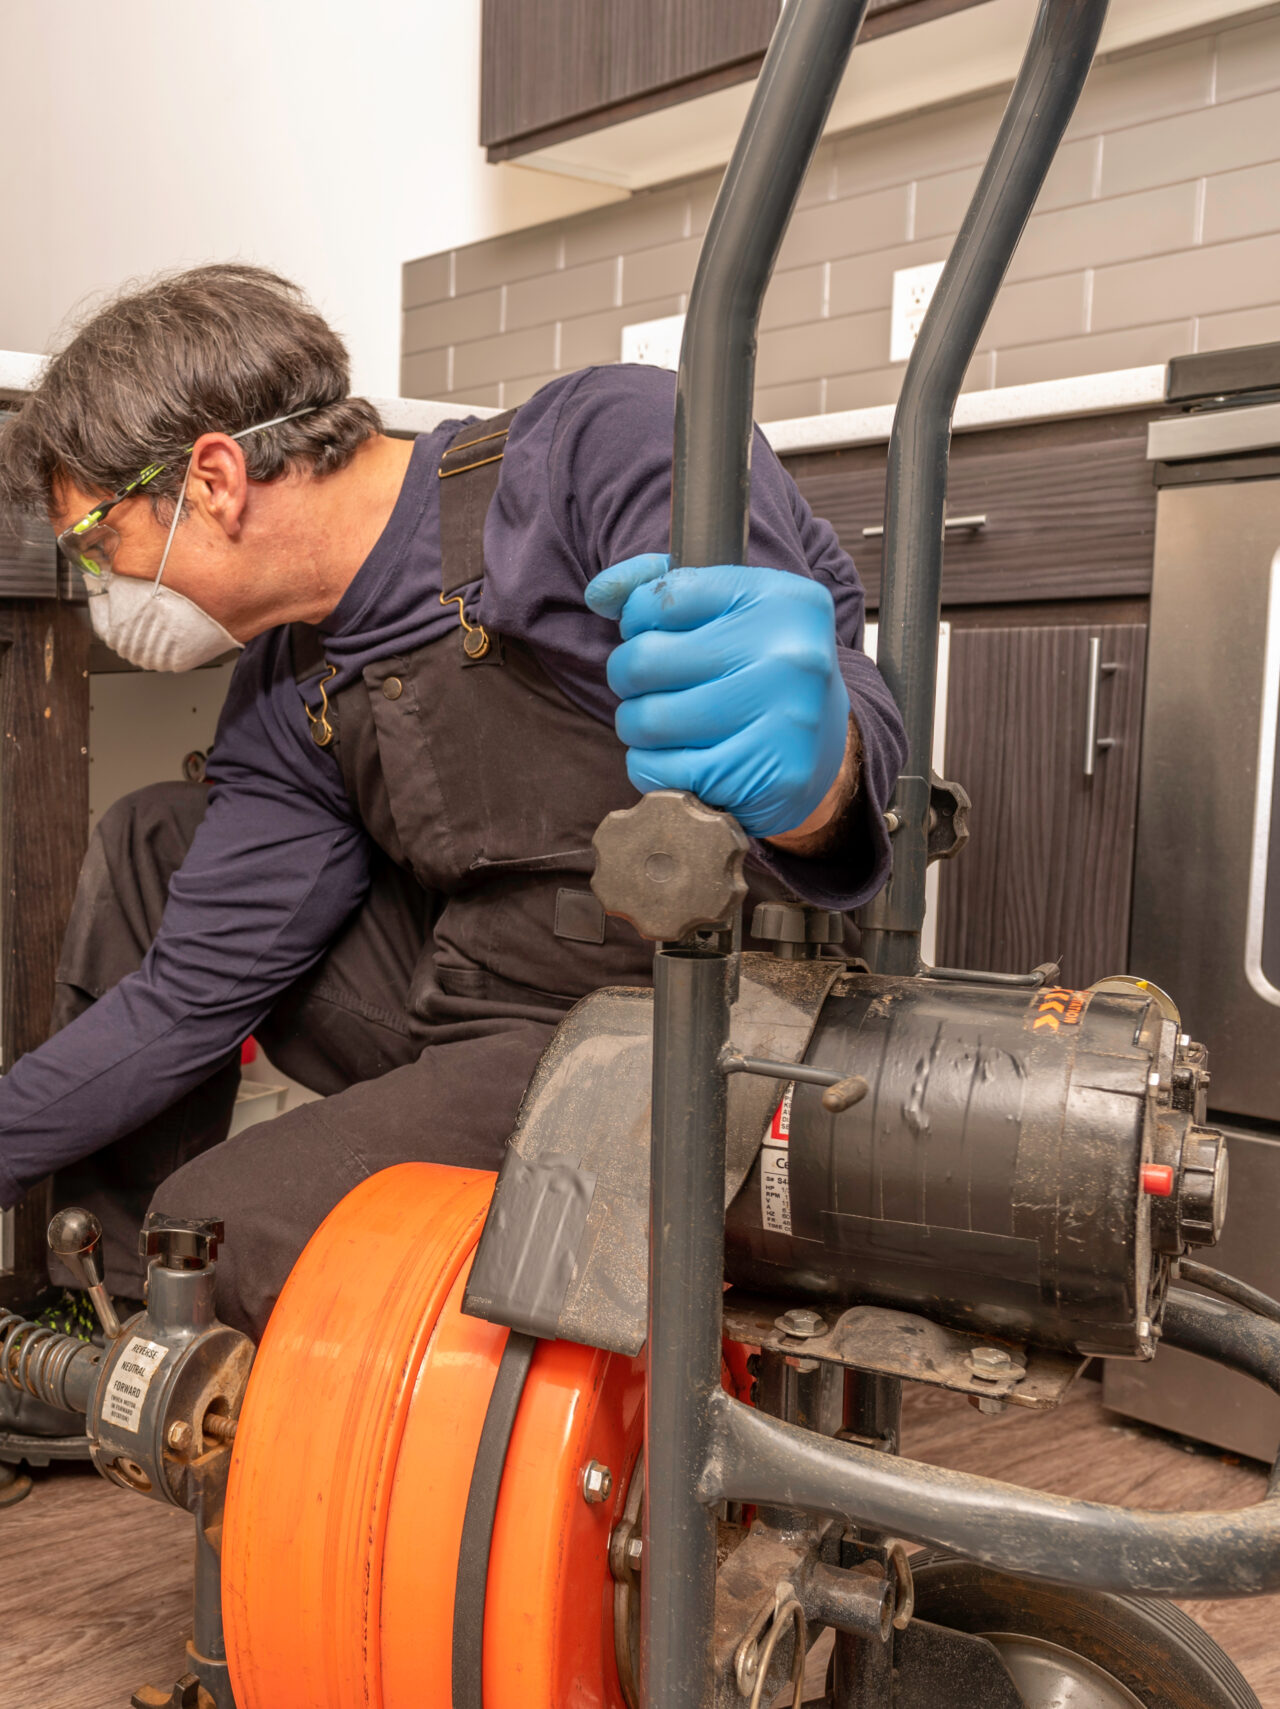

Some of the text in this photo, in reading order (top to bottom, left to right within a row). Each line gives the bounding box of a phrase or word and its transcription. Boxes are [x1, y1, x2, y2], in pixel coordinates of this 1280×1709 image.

[765, 1191, 780, 1199] RPM
[132, 1344, 158, 1359] REVERSE
[121, 1361, 146, 1377] NEUTRAL
[113, 1380, 141, 1398] FORWARD
